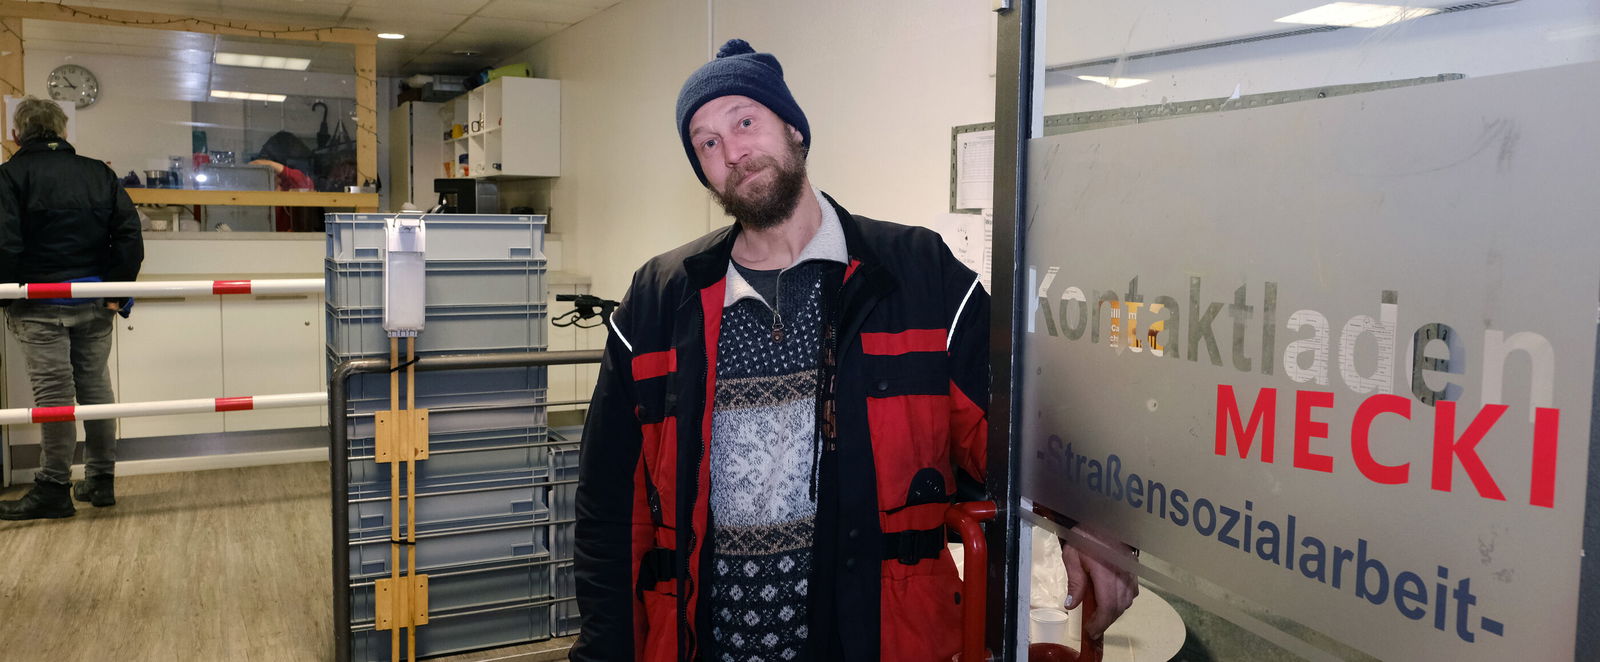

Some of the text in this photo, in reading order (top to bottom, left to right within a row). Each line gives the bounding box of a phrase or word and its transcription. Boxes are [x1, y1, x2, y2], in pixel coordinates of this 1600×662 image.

[1028, 266, 1555, 423] Kontaktladen
[1215, 384, 1560, 508] MECKI
[1037, 434, 1504, 643] -Straßensozialarbeit-
